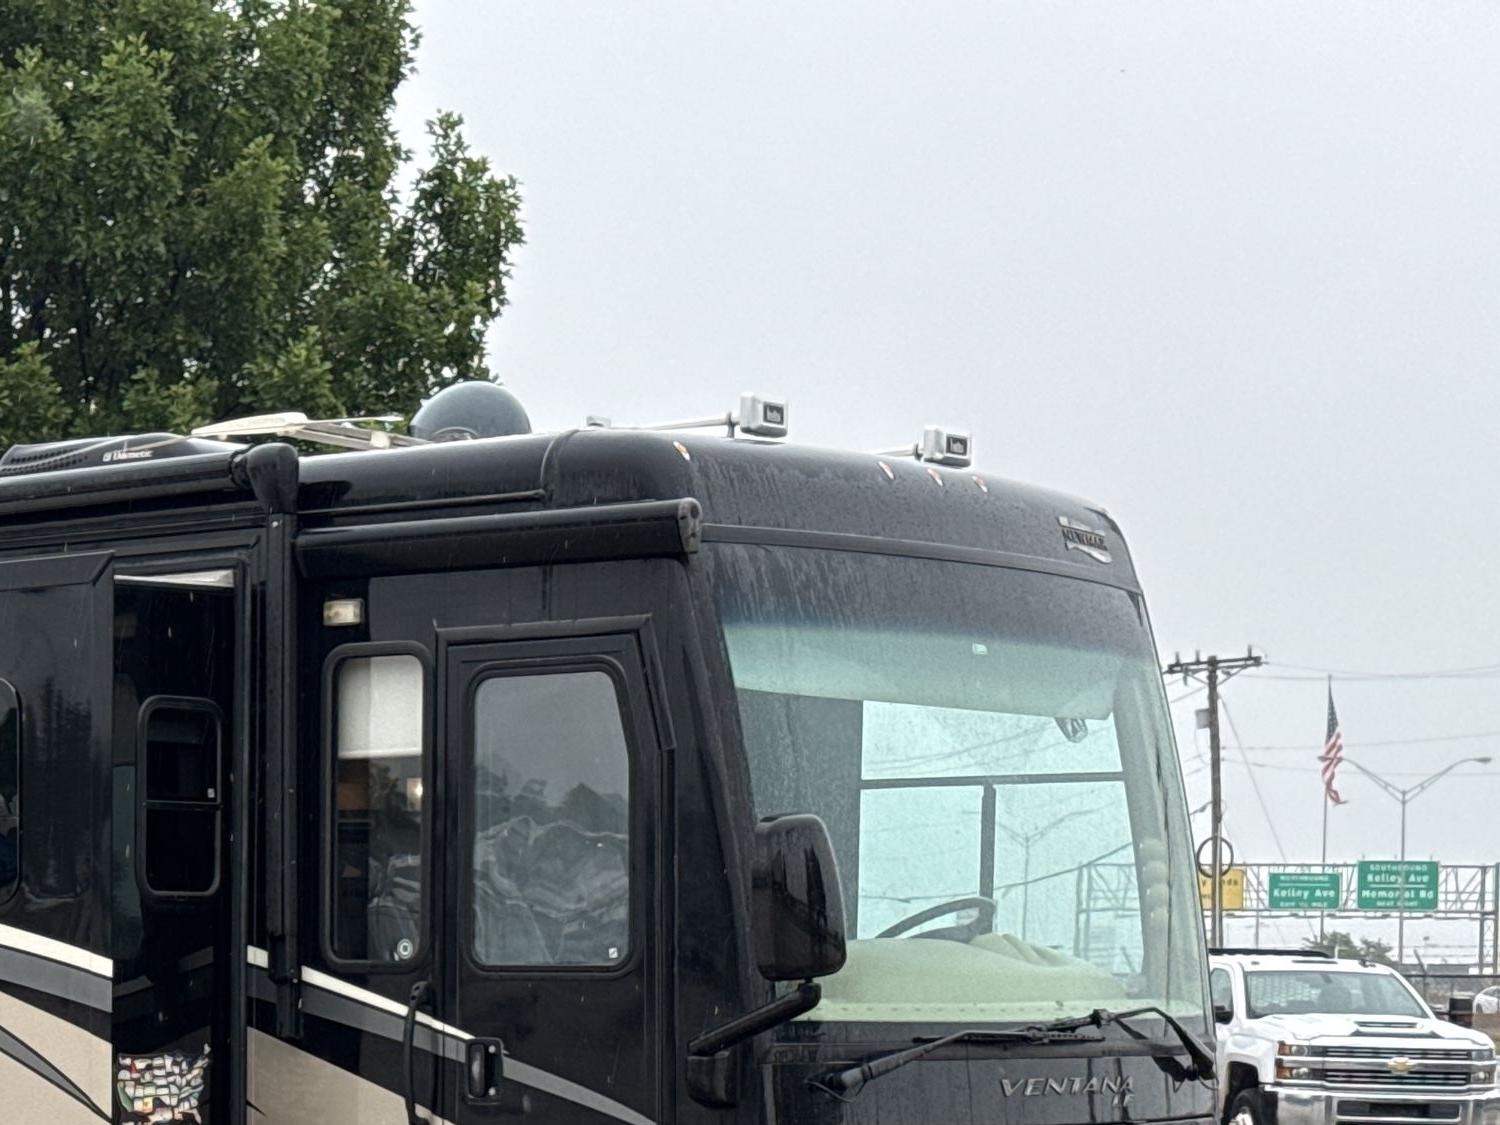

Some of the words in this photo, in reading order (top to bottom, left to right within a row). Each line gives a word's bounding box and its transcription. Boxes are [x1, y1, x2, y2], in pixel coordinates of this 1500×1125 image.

[1366, 872, 1402, 884] Kelley
[1408, 873, 1430, 883] Ave
[1273, 888, 1309, 900] Kelley
[1314, 888, 1336, 898] Ave
[1361, 889, 1415, 899] Memoral
[1419, 889, 1434, 900] Rd
[1000, 1075, 1135, 1097] VENTANA
